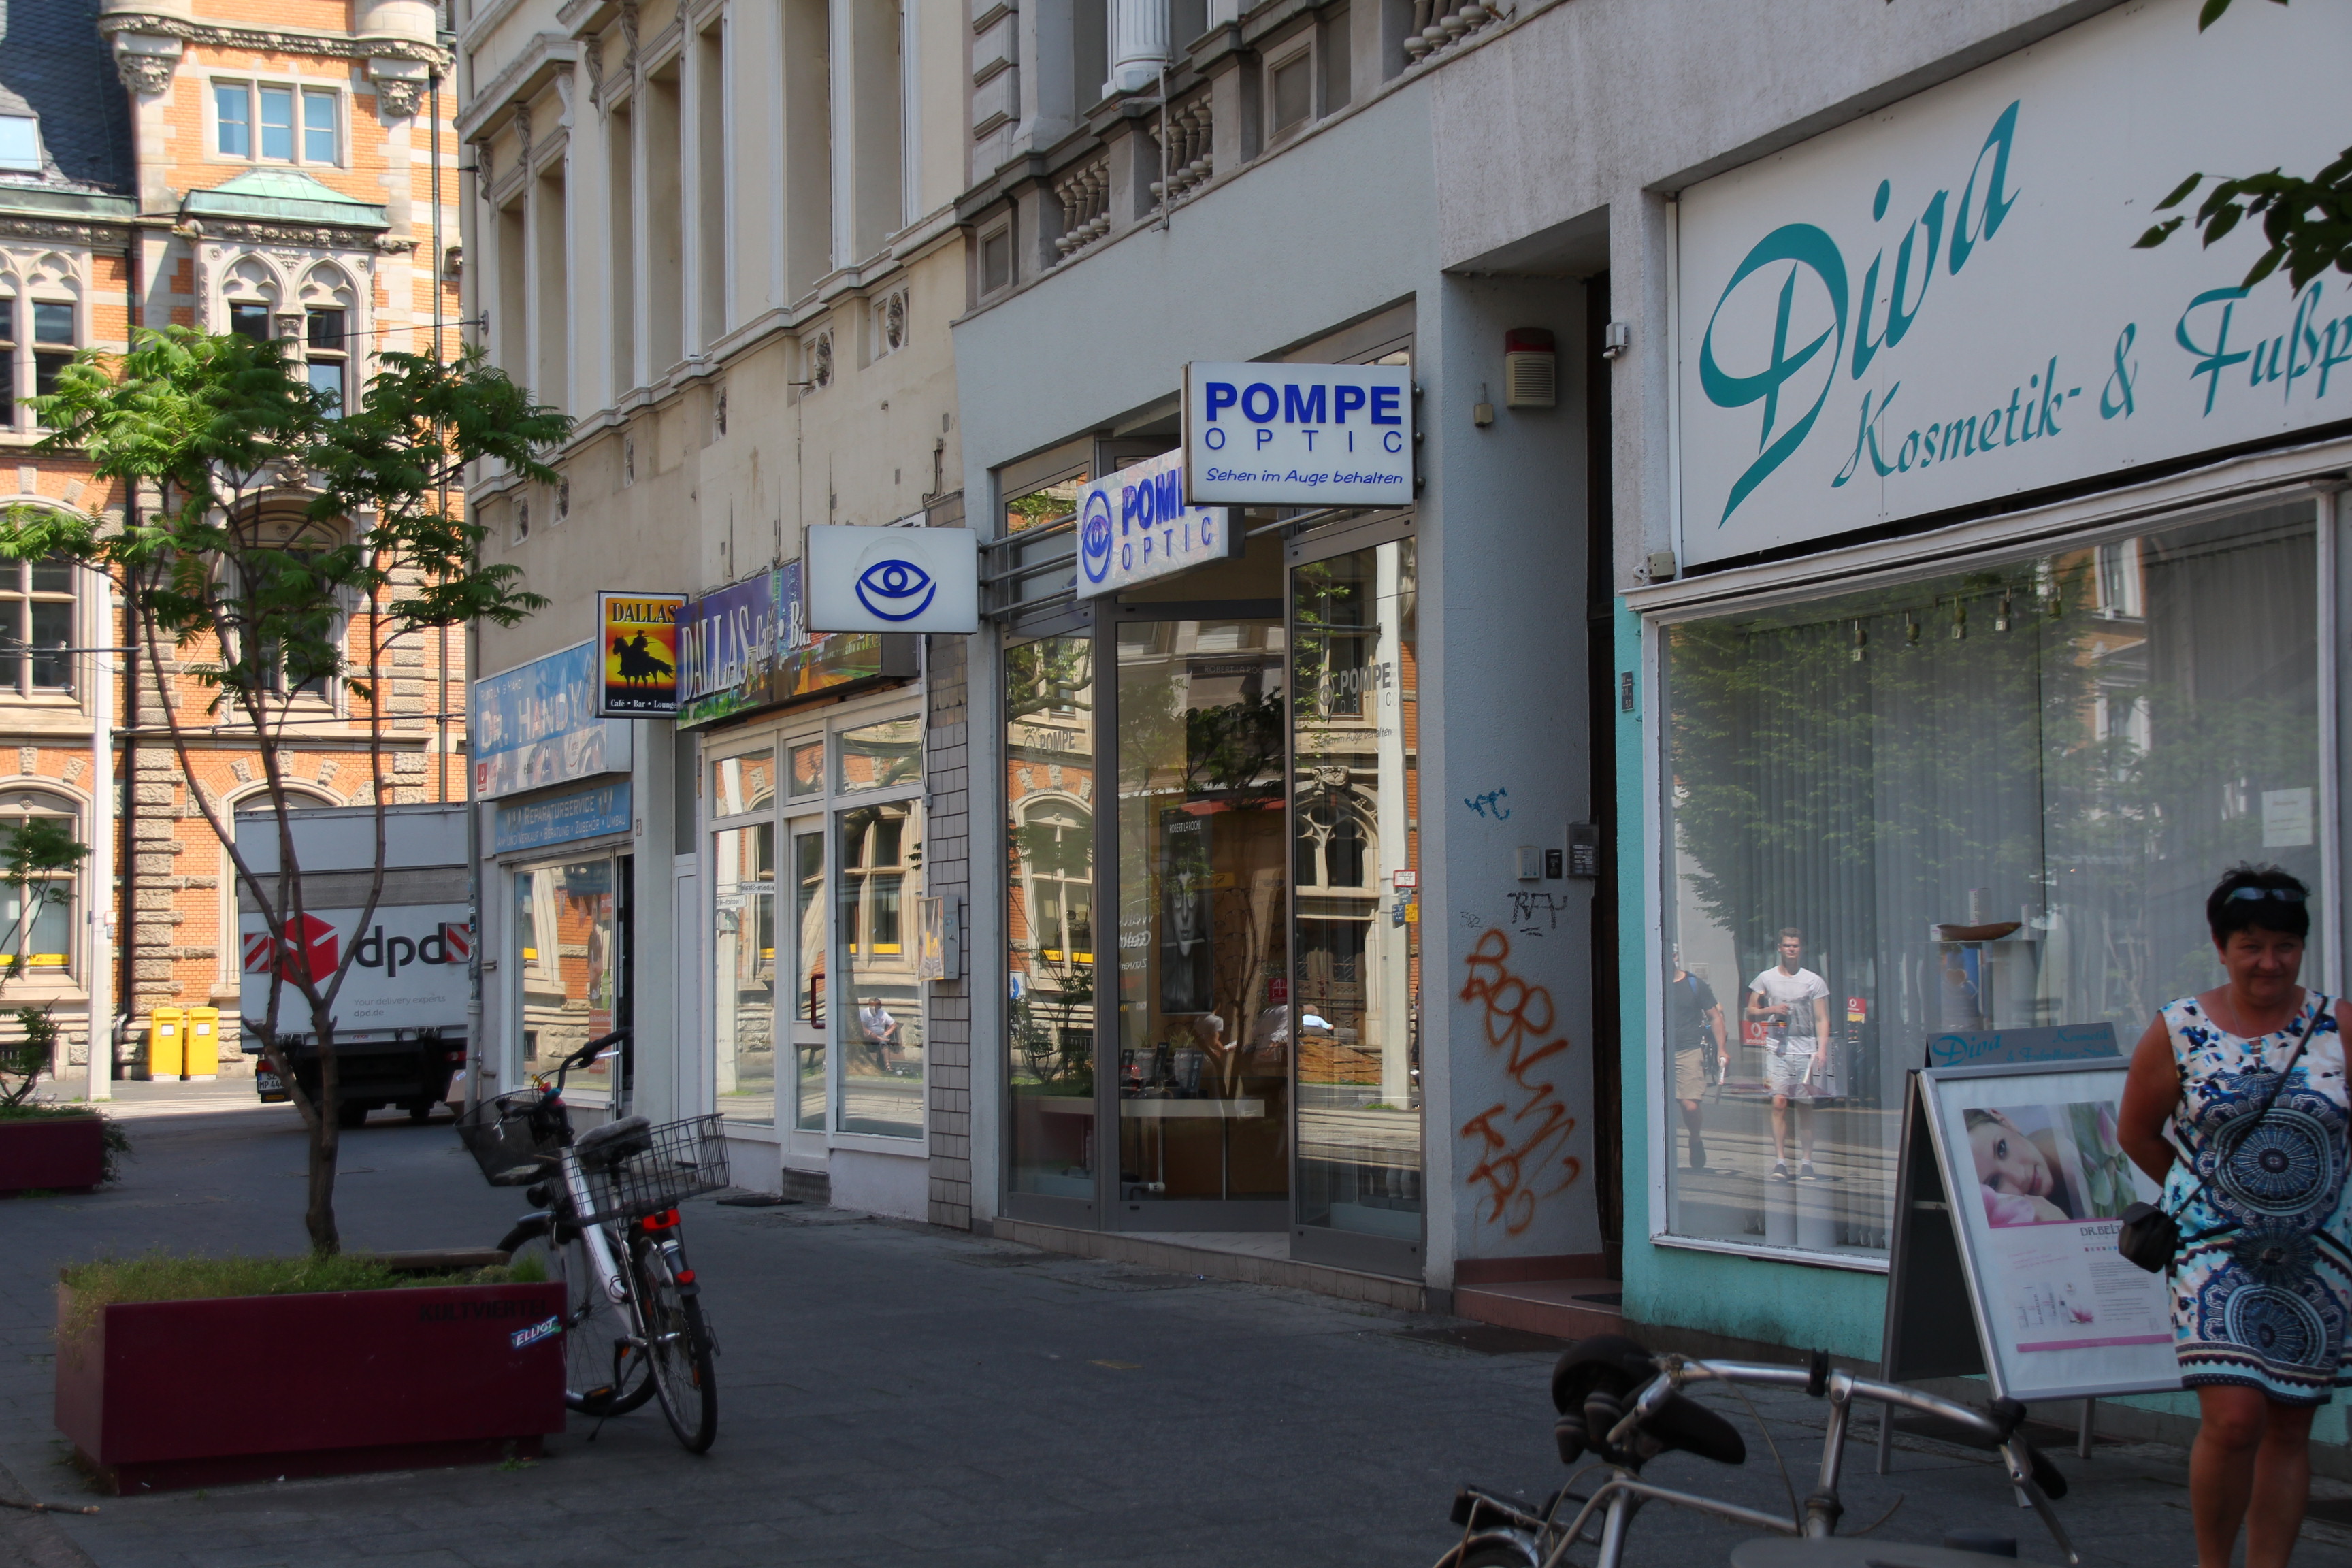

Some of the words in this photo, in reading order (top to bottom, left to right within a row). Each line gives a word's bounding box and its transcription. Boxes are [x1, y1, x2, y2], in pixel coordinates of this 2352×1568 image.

[1699, 99, 2021, 530] Diva
[1831, 355, 2082, 488] Kosmetik-
[2099, 323, 2138, 421] &
[2176, 280, 2352, 419] Fußp
[1205, 382, 1402, 425] POMPE
[1205, 427, 1403, 453] OPTIC
[1206, 467, 1256, 482] Sehen
[1261, 470, 1280, 483] im
[1284, 470, 1328, 486] Auge
[1333, 470, 1403, 484] behalten
[1122, 466, 1208, 536] POM
[1122, 517, 1212, 570] OPTIC
[612, 602, 677, 624] DALLAS
[682, 604, 749, 702] DALLAS
[755, 609, 774, 662] Café
[1340, 662, 1391, 696] POMPE
[518, 679, 583, 743] HANDY
[610, 698, 625, 708] Café
[633, 700, 646, 708] Bar
[653, 700, 677, 710] Lounge
[1340, 691, 1392, 714] OPTIC
[1039, 728, 1075, 755] POMPE
[355, 921, 448, 978] dpd
[354, 998, 374, 1007] Your
[378, 996, 411, 1007] delivery
[412, 995, 446, 1004] experts
[354, 1009, 385, 1018] dpd.de
[1931, 1034, 2002, 1068] Diva
[259, 1081, 269, 1090] MP
[515, 1318, 555, 1347] ELLIOT
